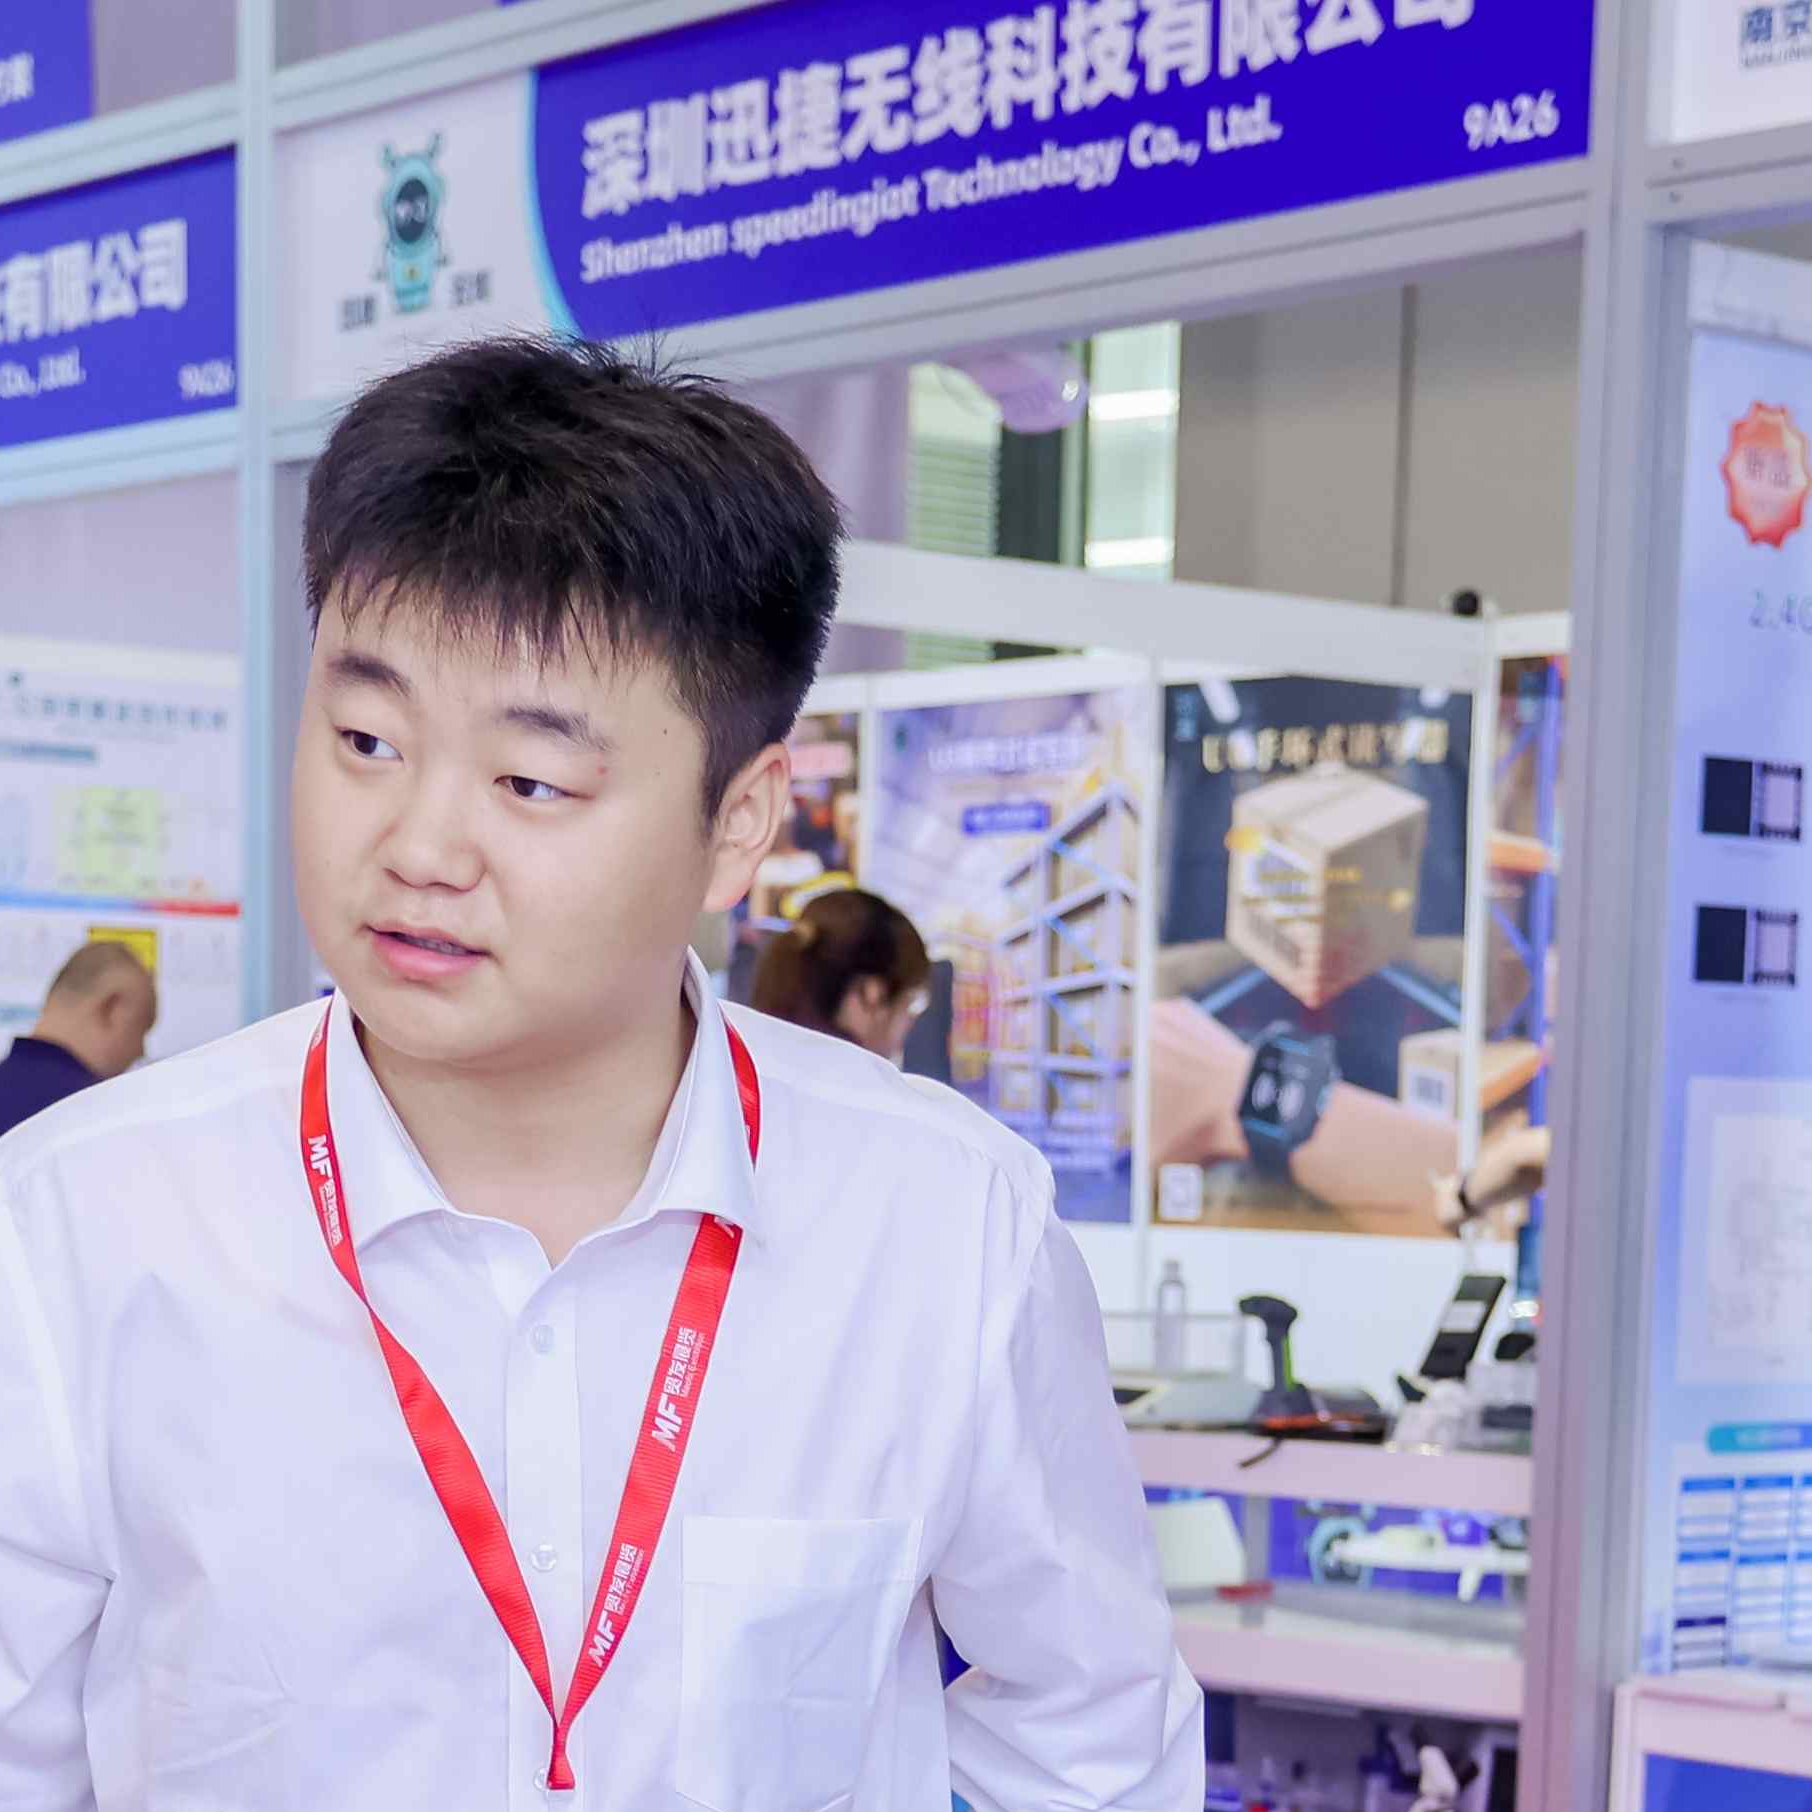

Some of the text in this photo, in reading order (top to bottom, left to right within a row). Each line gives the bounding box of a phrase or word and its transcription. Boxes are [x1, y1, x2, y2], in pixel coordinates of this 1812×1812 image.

[1463, 92, 1560, 150] 9A26
[581, 224, 725, 282] Shenzhen
[921, 138, 1125, 212] Technology
[1206, 95, 1282, 152] Ltd.
[650, 1399, 681, 1452] MF
[587, 1609, 615, 1666] MF
